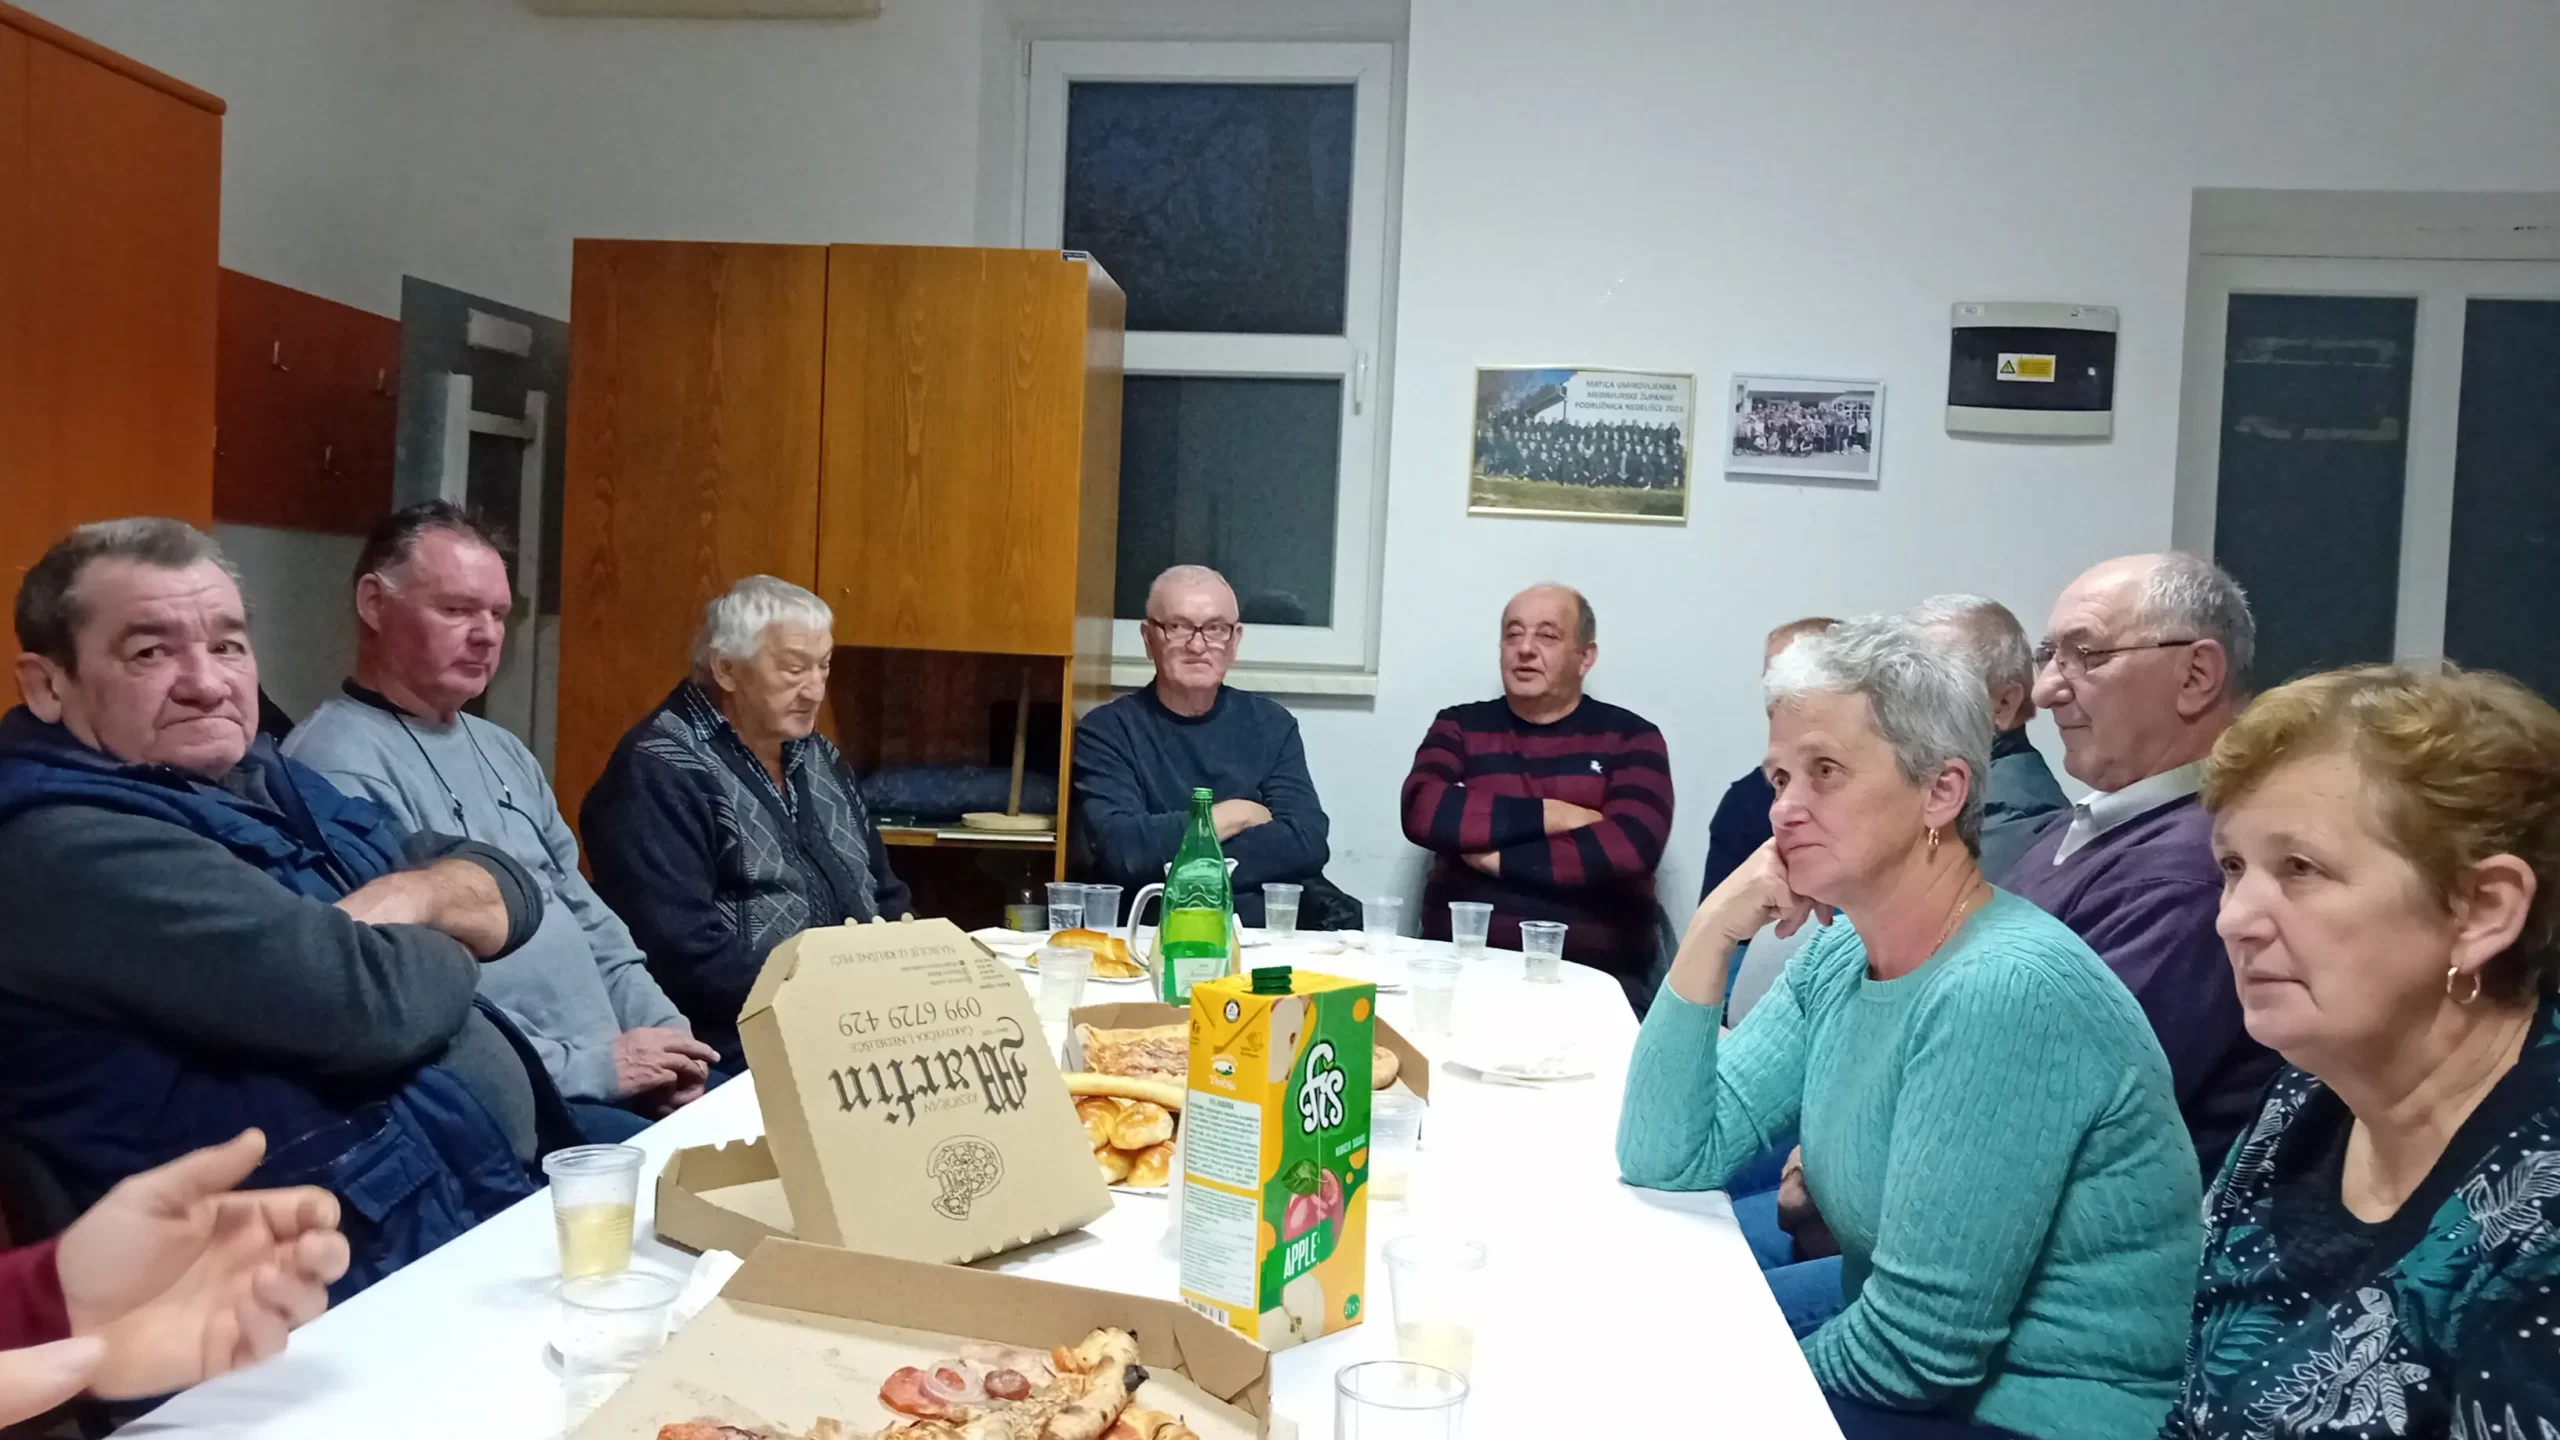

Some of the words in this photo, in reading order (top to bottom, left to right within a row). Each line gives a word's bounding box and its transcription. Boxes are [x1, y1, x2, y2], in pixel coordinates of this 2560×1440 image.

[1586, 380, 1615, 389] MATICA
[1616, 381, 1677, 391] UMIROVLJENIKA
[1574, 401, 1623, 410] PODRUŽNICA
[855, 949, 897, 964] KRUŠNE
[888, 1001, 937, 1030] 6729
[944, 996, 982, 1021] 099
[838, 1010, 881, 1037] 429
[916, 1024, 974, 1043] ČAKOVEČKA
[850, 1035, 908, 1054] NEDELIŠĆE
[828, 1016, 1028, 1127] Martin
[1283, 1231, 1318, 1280] APPLE
